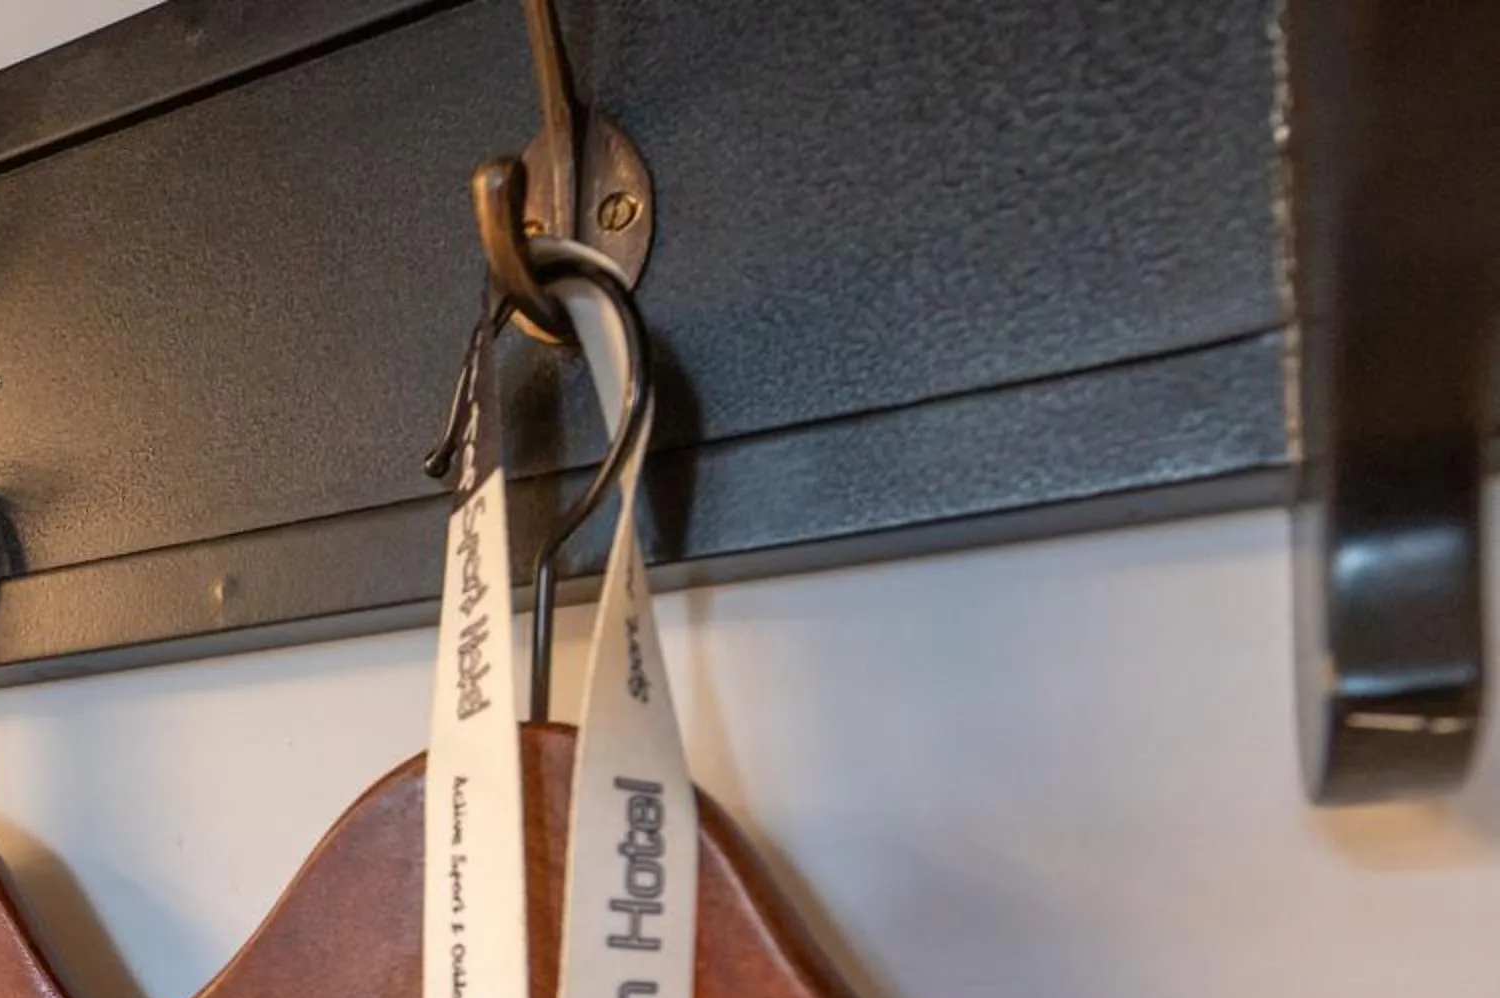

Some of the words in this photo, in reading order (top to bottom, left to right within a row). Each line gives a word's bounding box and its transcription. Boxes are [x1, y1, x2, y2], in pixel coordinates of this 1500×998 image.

[451, 776, 468, 847] Active
[448, 853, 468, 917] Sport
[607, 776, 665, 952] Hotel
